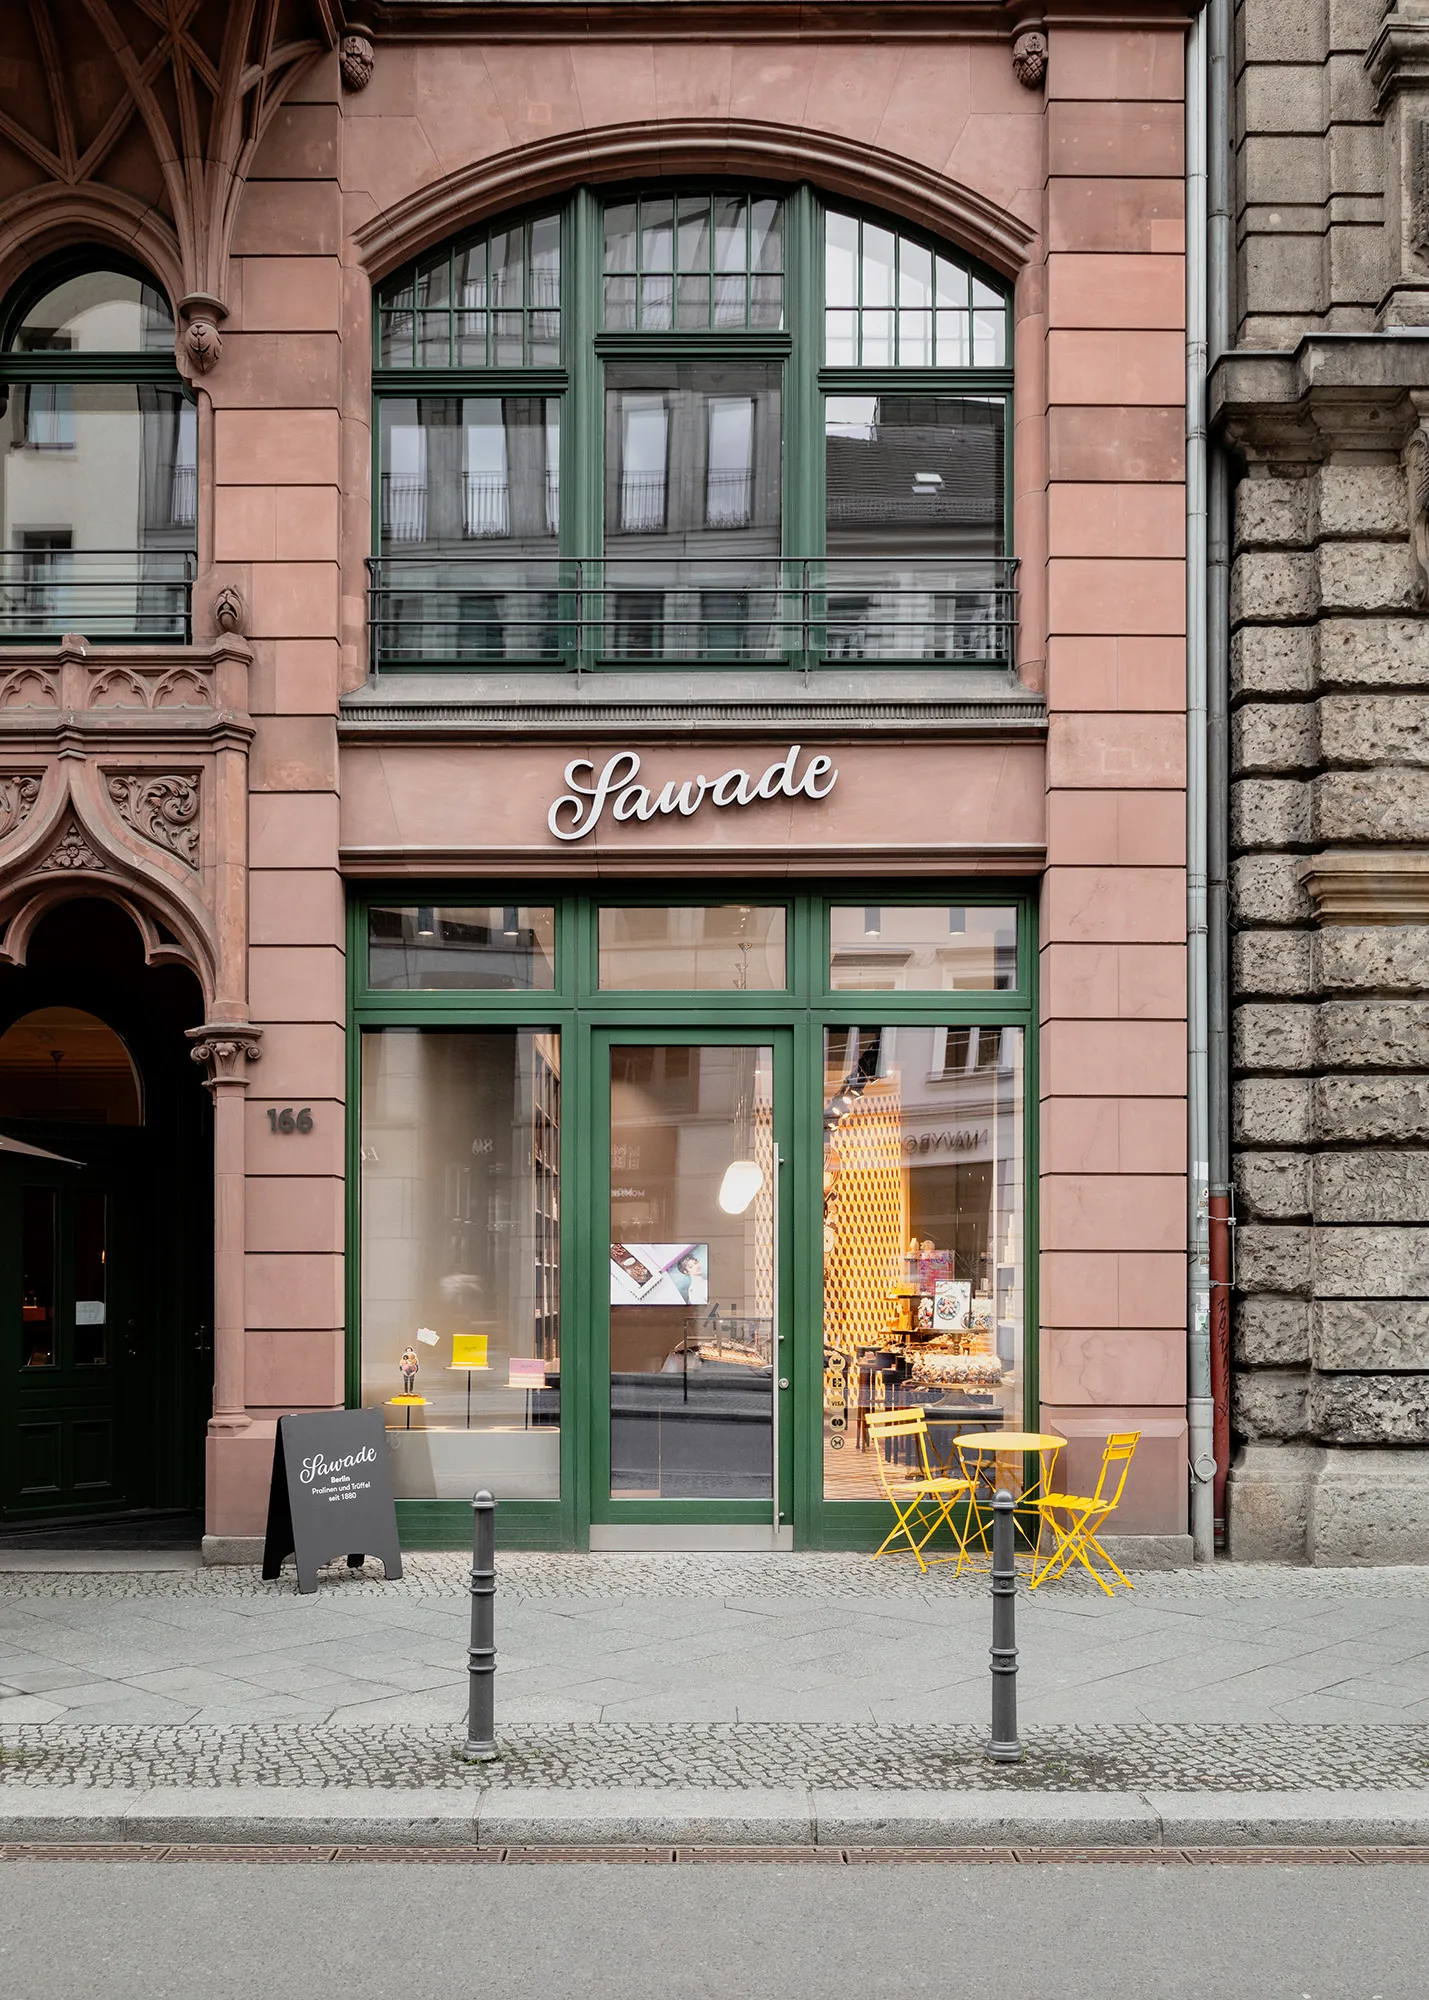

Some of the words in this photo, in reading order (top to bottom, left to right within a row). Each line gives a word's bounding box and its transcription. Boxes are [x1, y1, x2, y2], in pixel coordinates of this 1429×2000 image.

[547, 745, 839, 841] Sawade
[266, 1107, 313, 1134] 166
[300, 1446, 377, 1484] Sawade
[311, 1486, 338, 1495] Pralinen
[338, 1483, 351, 1491] und
[351, 1481, 371, 1490] Trüffel
[330, 1475, 351, 1483] Berlin
[328, 1494, 340, 1502] seit
[341, 1492, 357, 1500] 1880
